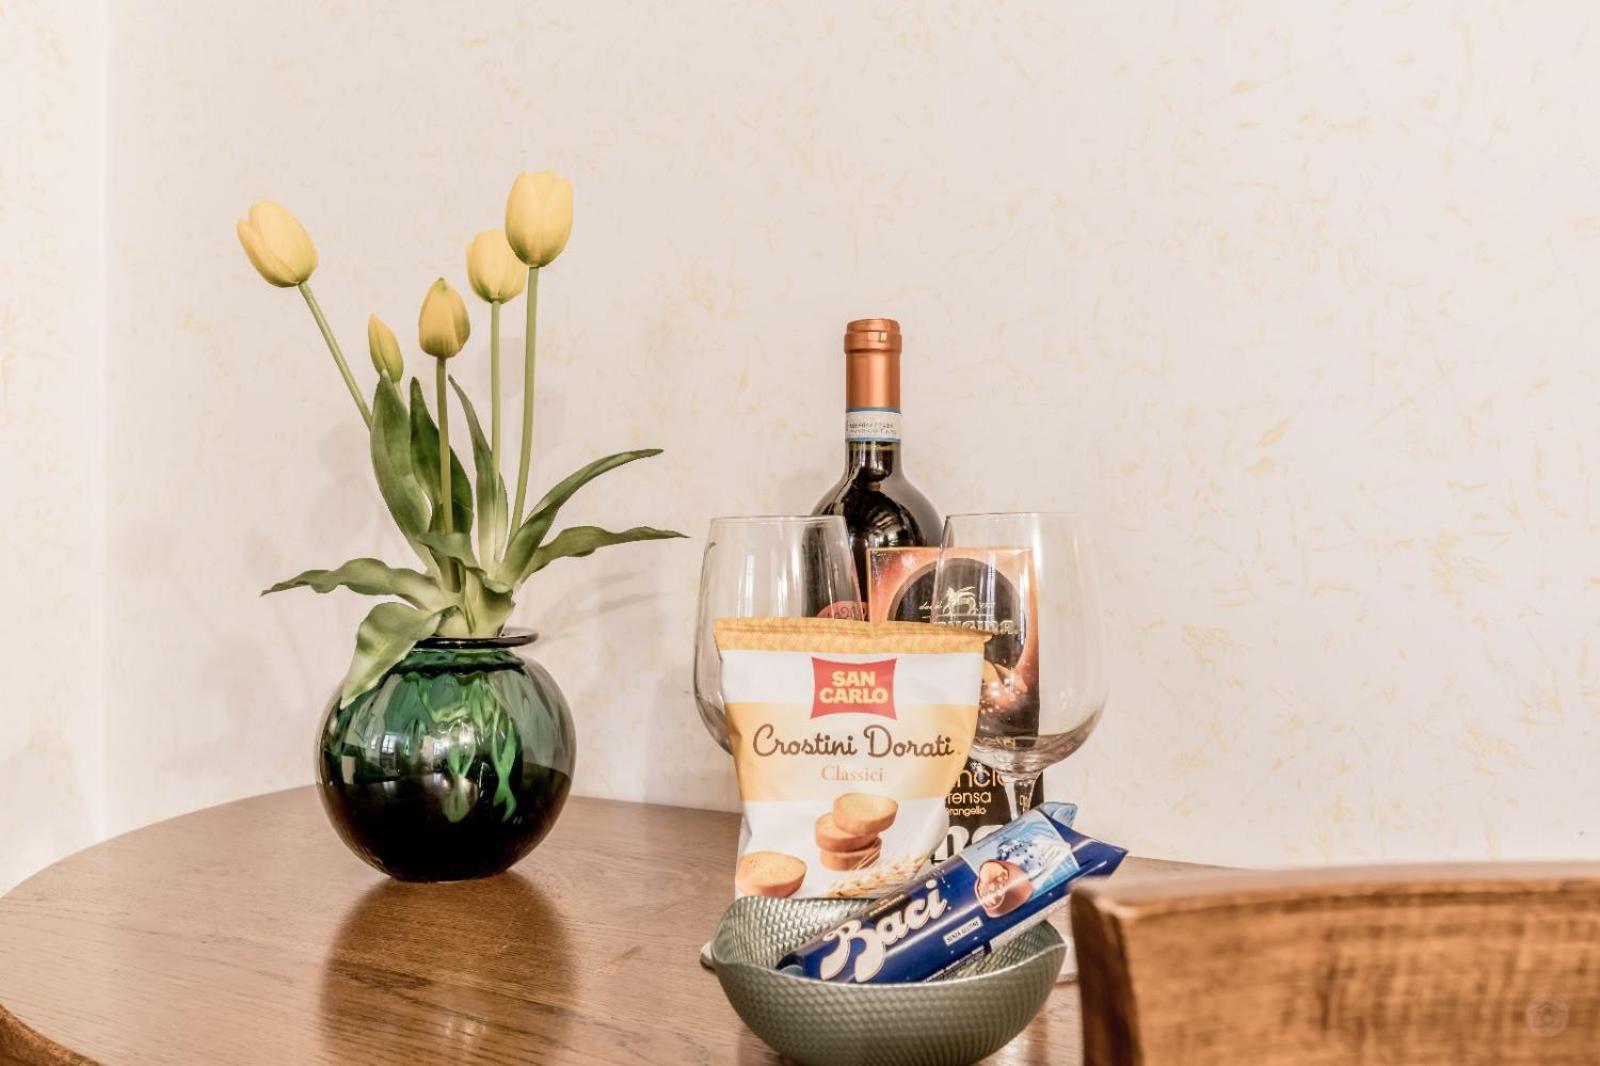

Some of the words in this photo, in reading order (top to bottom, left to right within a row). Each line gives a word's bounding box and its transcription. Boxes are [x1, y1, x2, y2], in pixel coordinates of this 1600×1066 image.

[832, 670, 876, 687] SAN
[819, 687, 889, 704] CARLO
[752, 723, 858, 757] Crostini
[863, 724, 955, 758] Dorati
[820, 764, 886, 783] Classici
[819, 879, 949, 983] Baci
